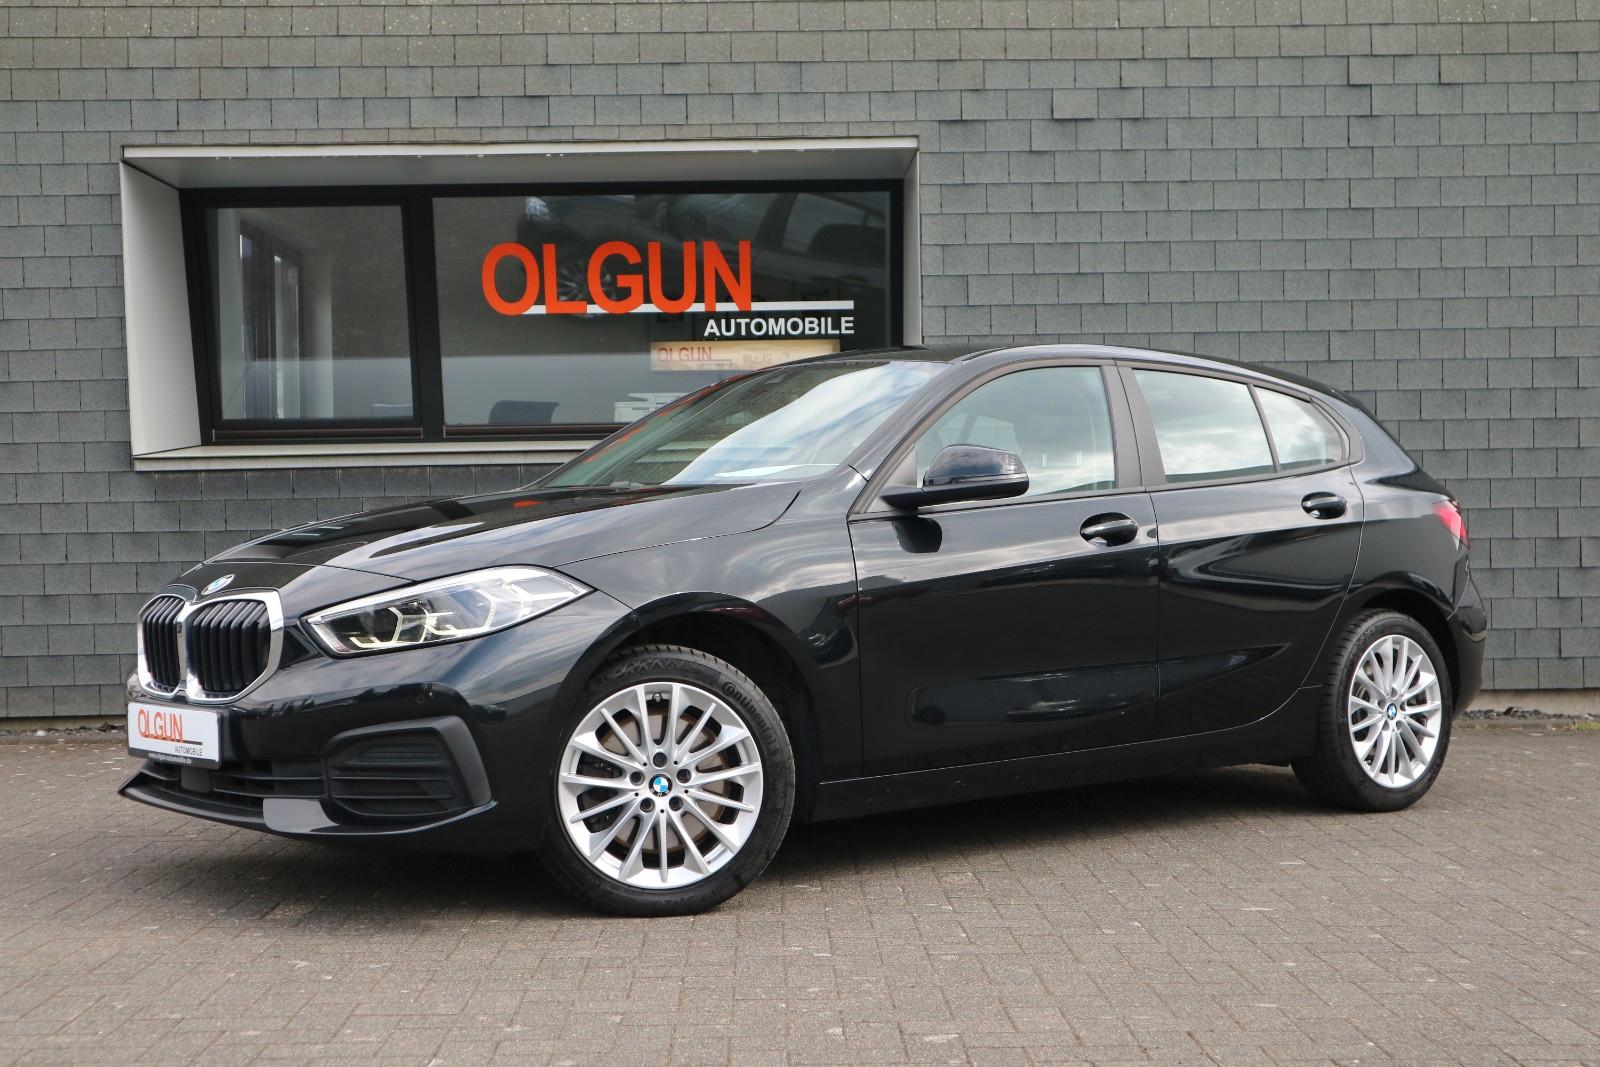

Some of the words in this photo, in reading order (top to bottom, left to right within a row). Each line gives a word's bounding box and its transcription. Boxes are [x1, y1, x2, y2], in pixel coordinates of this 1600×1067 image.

[481, 240, 752, 316] OLGUN
[704, 317, 854, 337] AUTOMOBILE
[657, 346, 713, 362] OLGUN
[137, 708, 185, 743] OLGUN
[174, 745, 203, 757] AUTOMOBILE
